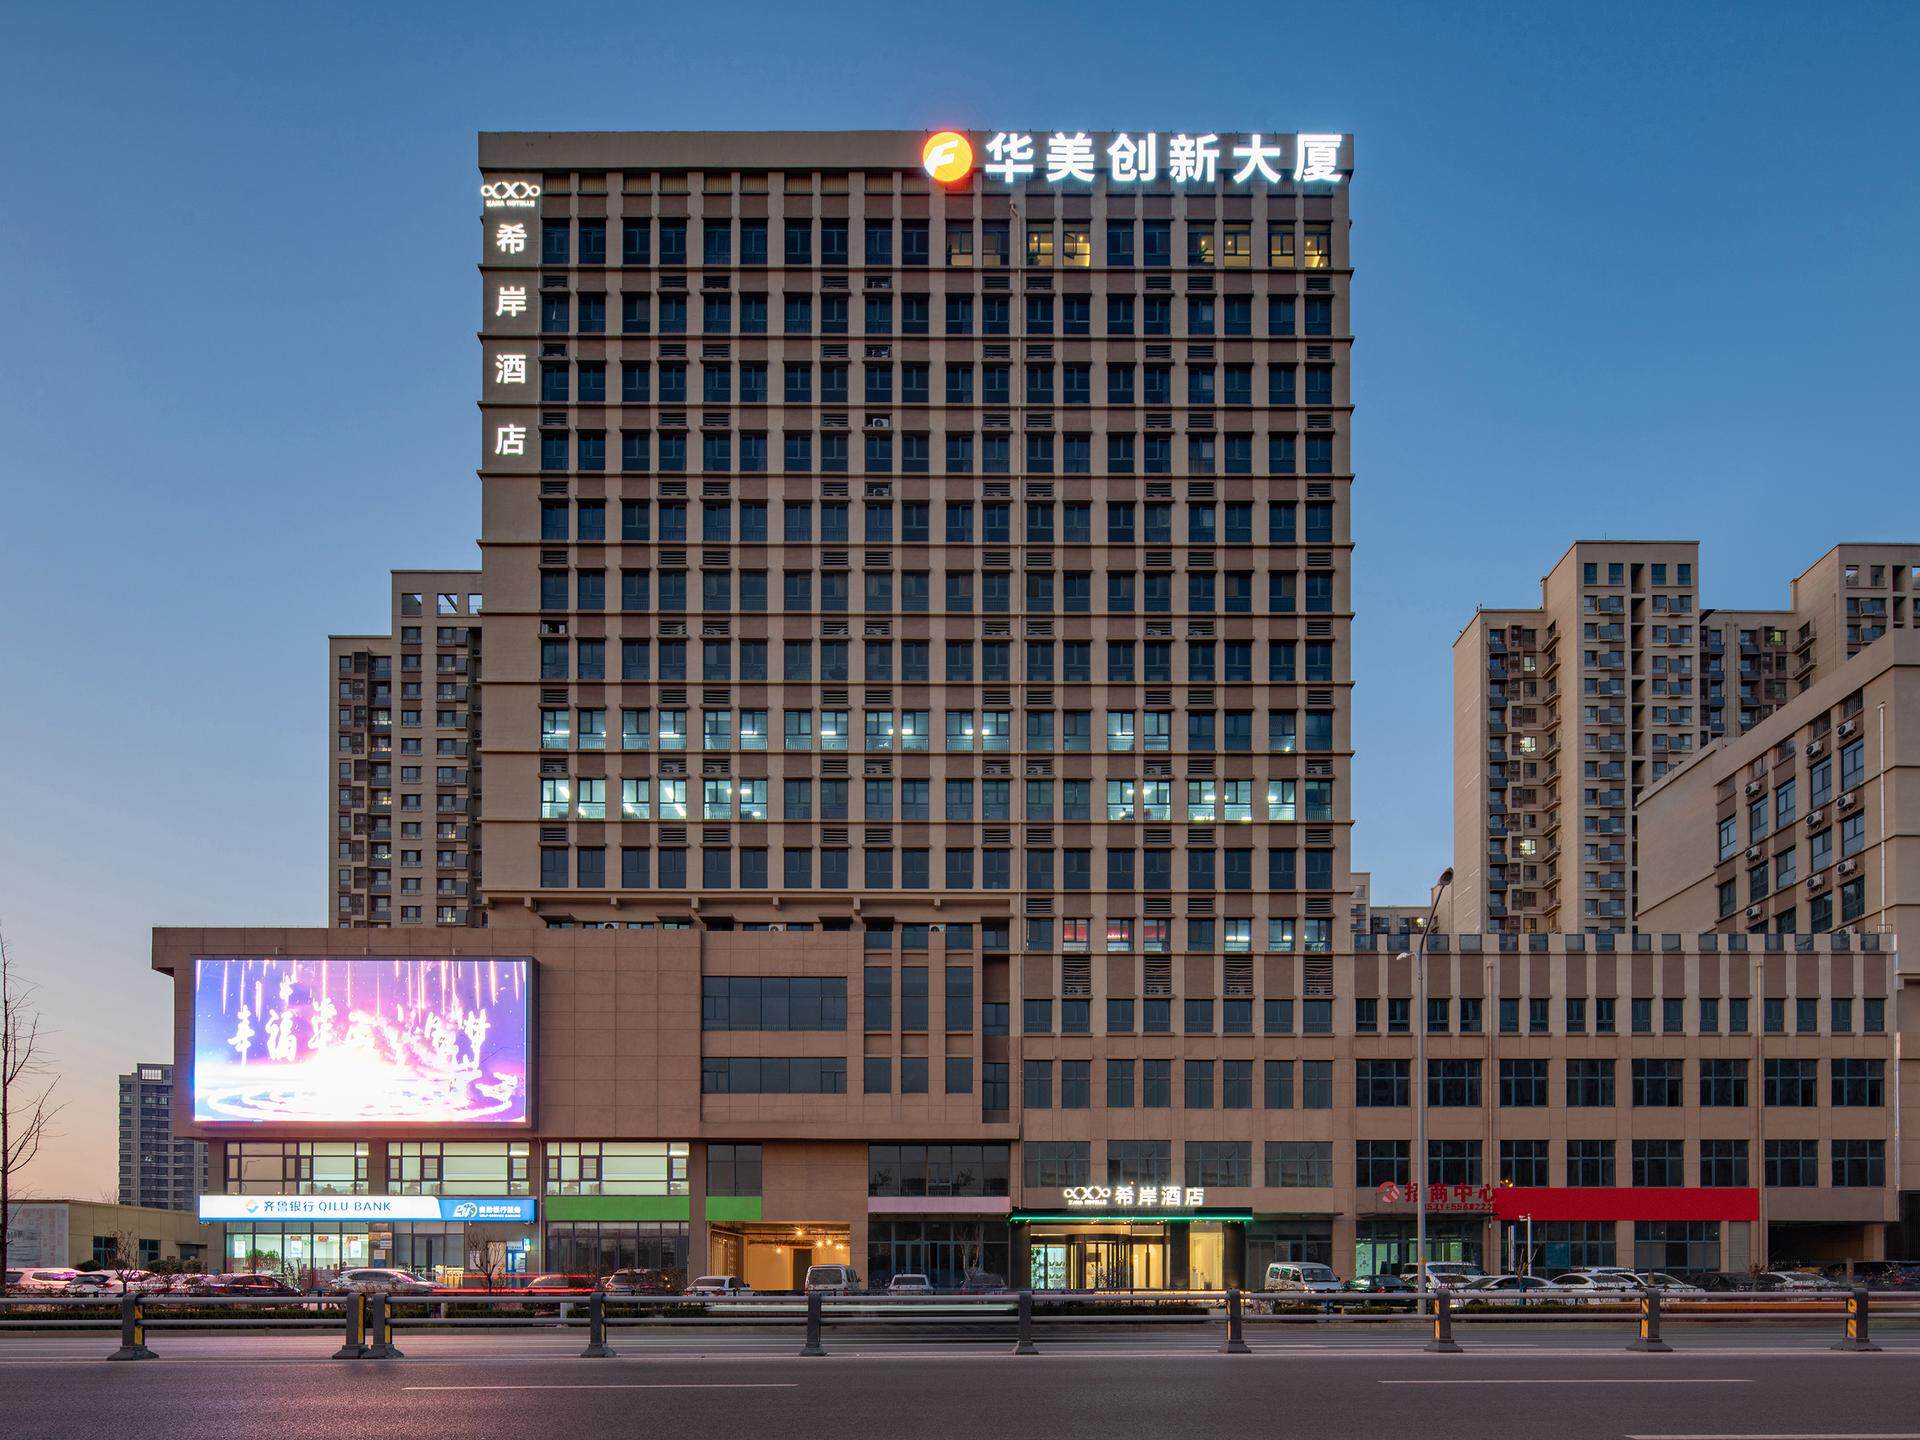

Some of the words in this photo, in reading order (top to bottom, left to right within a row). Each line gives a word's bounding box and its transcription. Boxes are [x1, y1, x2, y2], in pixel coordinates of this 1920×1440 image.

[985, 132, 1343, 183] 华美创新大厦
[495, 223, 527, 455] 希岸酒店
[264, 1201, 314, 1212] 齐鲁银行
[318, 1201, 348, 1213] QILU
[355, 1201, 391, 1212] BANK
[1115, 1186, 1205, 1206] 希岸酒店
